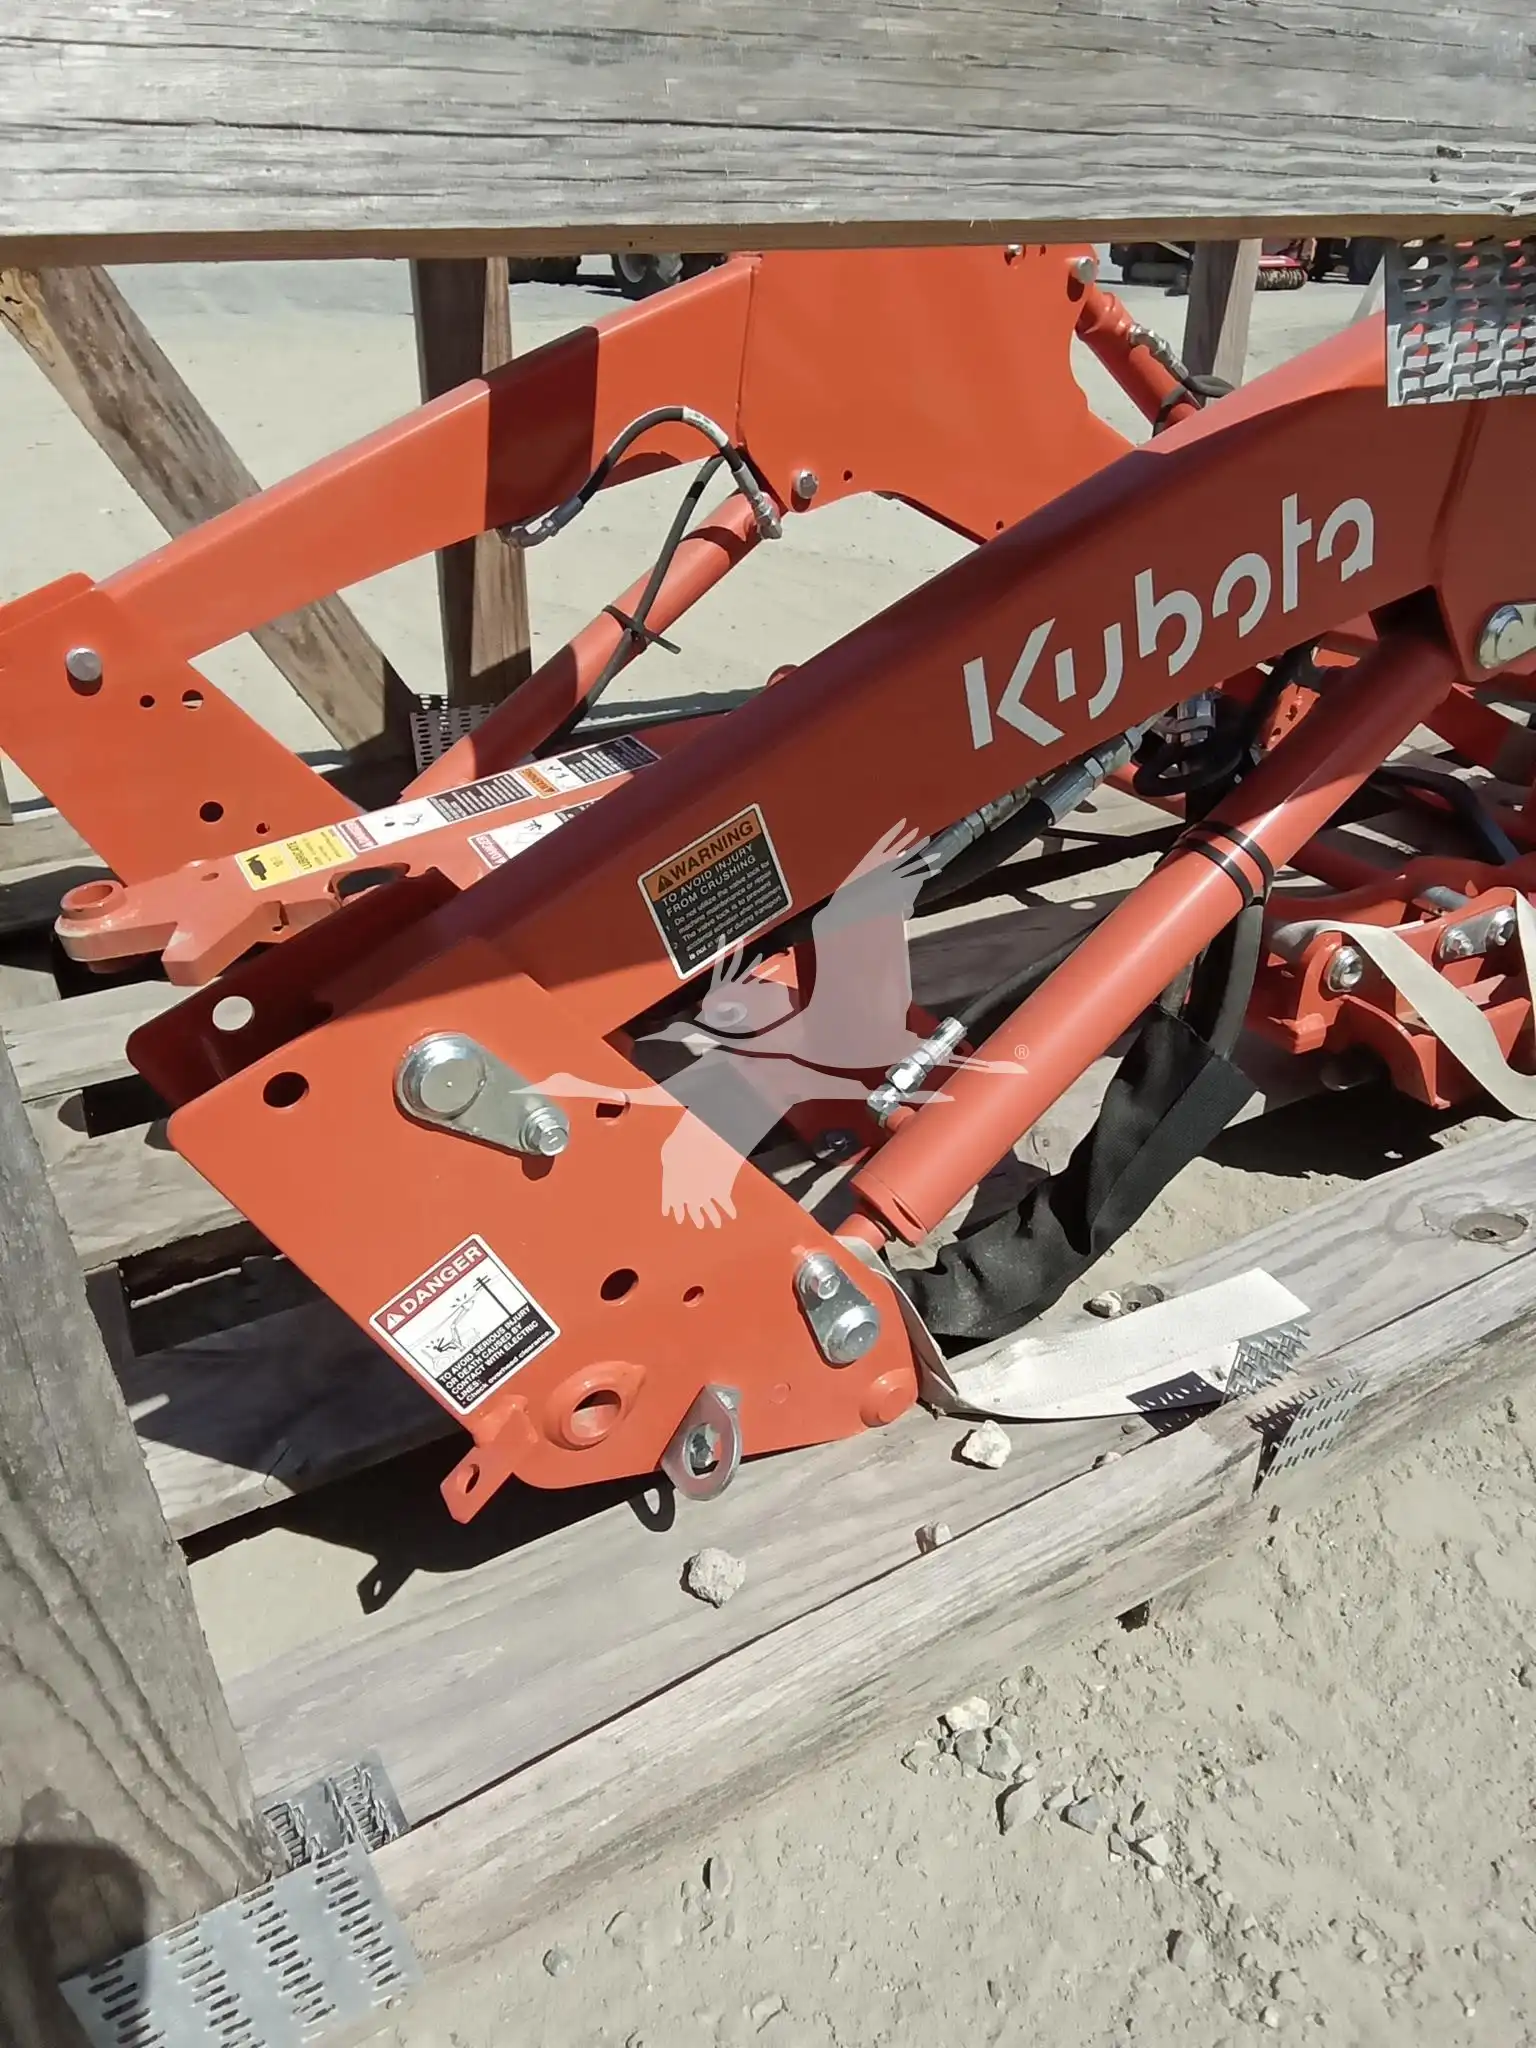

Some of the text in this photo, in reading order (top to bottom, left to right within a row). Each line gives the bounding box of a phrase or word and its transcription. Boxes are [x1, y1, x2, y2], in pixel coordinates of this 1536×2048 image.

[963, 493, 1375, 750] Kubota
[286, 839, 313, 869] LUBRICATE
[662, 843, 753, 907] TO AVOID INJURY
[670, 821, 754, 881] WARNING
[666, 854, 756, 917] FROM CRUSHING
[683, 930, 696, 942] The
[400, 1246, 482, 1314] DANGER
[439, 1305, 532, 1383] TO AVOID SERIOUS INJURY
[445, 1323, 523, 1389] OR DEATH CAUSED BY
[451, 1319, 539, 1396] CONTACT WITH ELECTRIC
[457, 1378, 482, 1401] LINES:
[466, 1382, 489, 1402] Check
[488, 1356, 519, 1385] overhead
